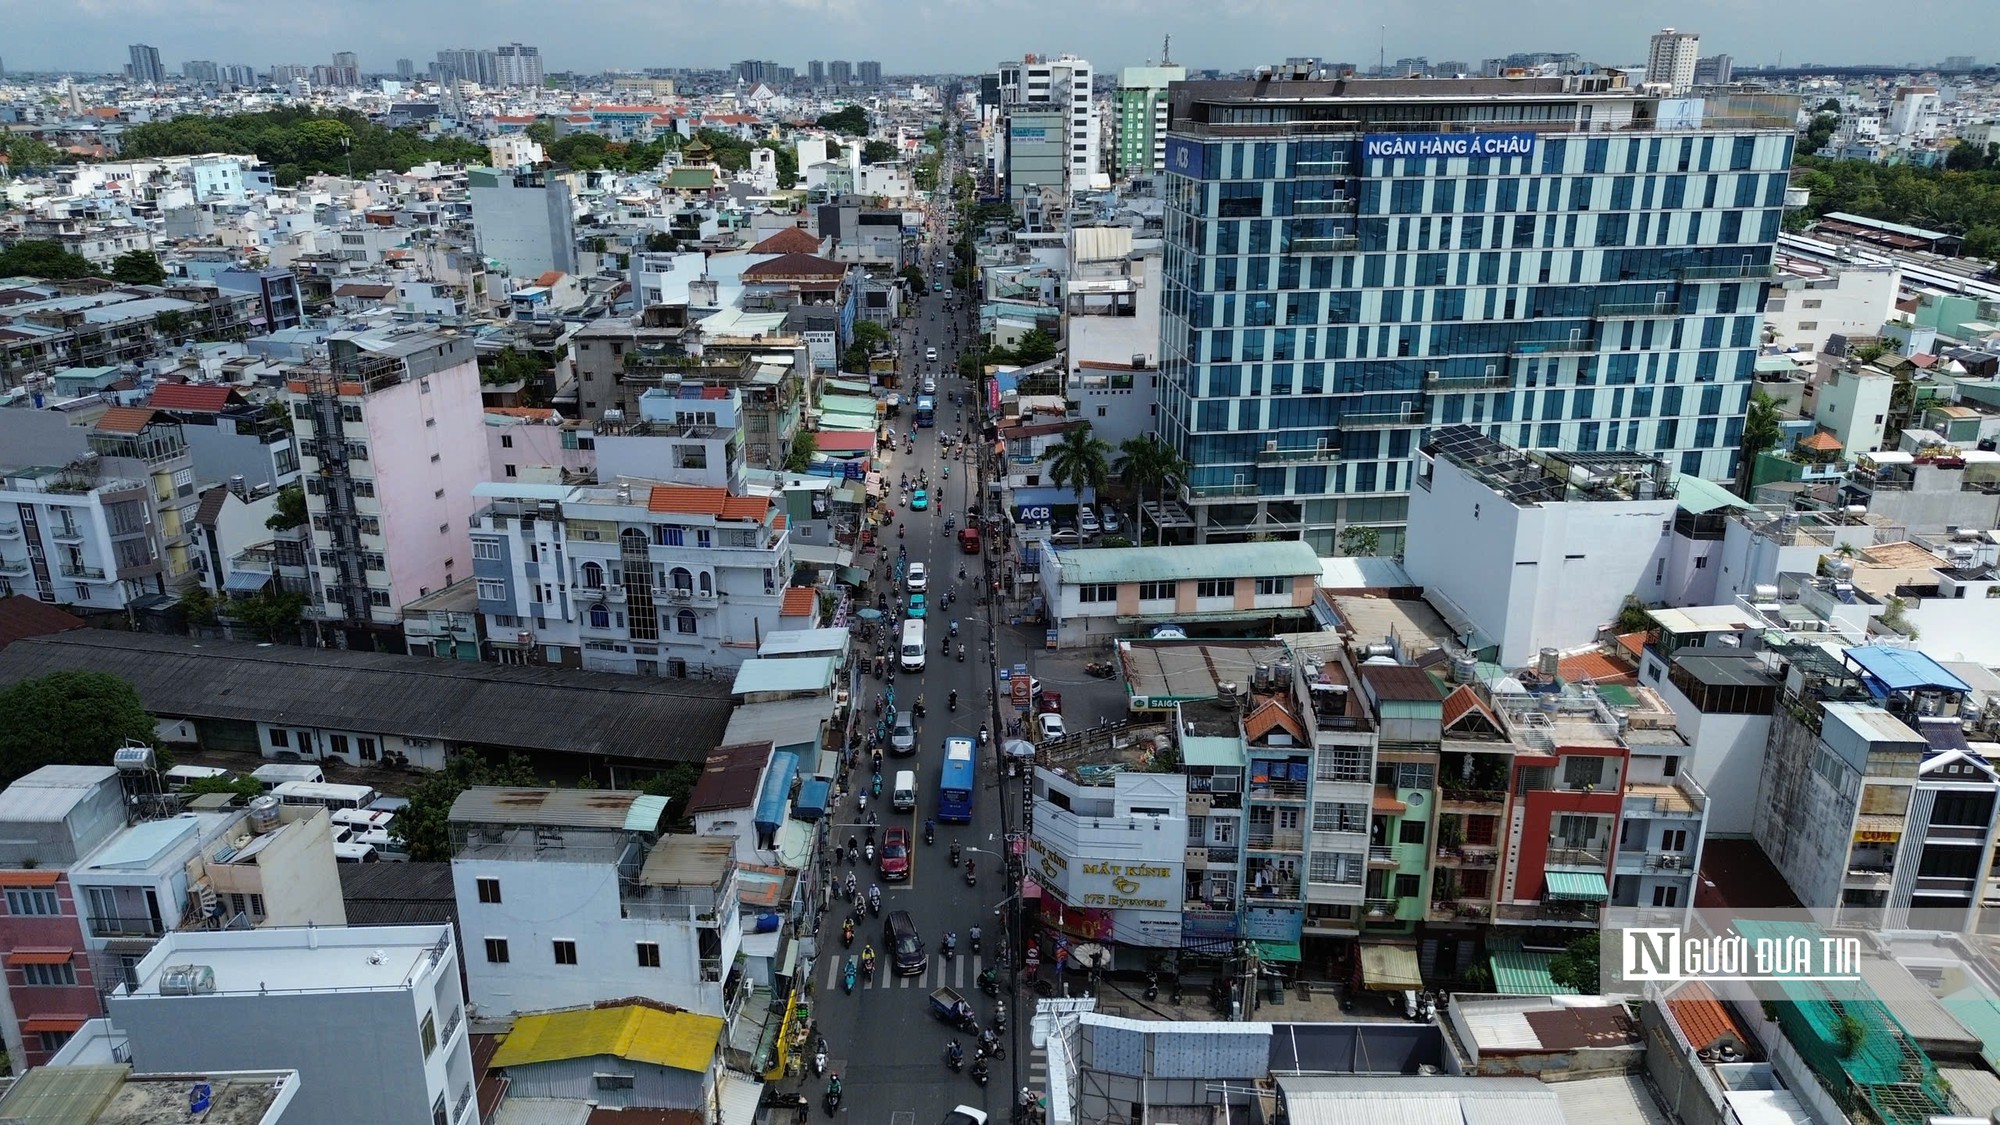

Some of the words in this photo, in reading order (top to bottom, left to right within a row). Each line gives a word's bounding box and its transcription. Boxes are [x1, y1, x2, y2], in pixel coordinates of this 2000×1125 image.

[1368, 138, 1417, 155] NGÂN
[1420, 137, 1467, 155] HÀNG
[1470, 136, 1482, 154] Á
[1485, 136, 1531, 153] CHÂU
[1021, 507, 1050, 520] ACB
[1125, 863, 1171, 878] KÍNH
[1084, 894, 1106, 904] 175
[1108, 895, 1168, 908] Eyewear
